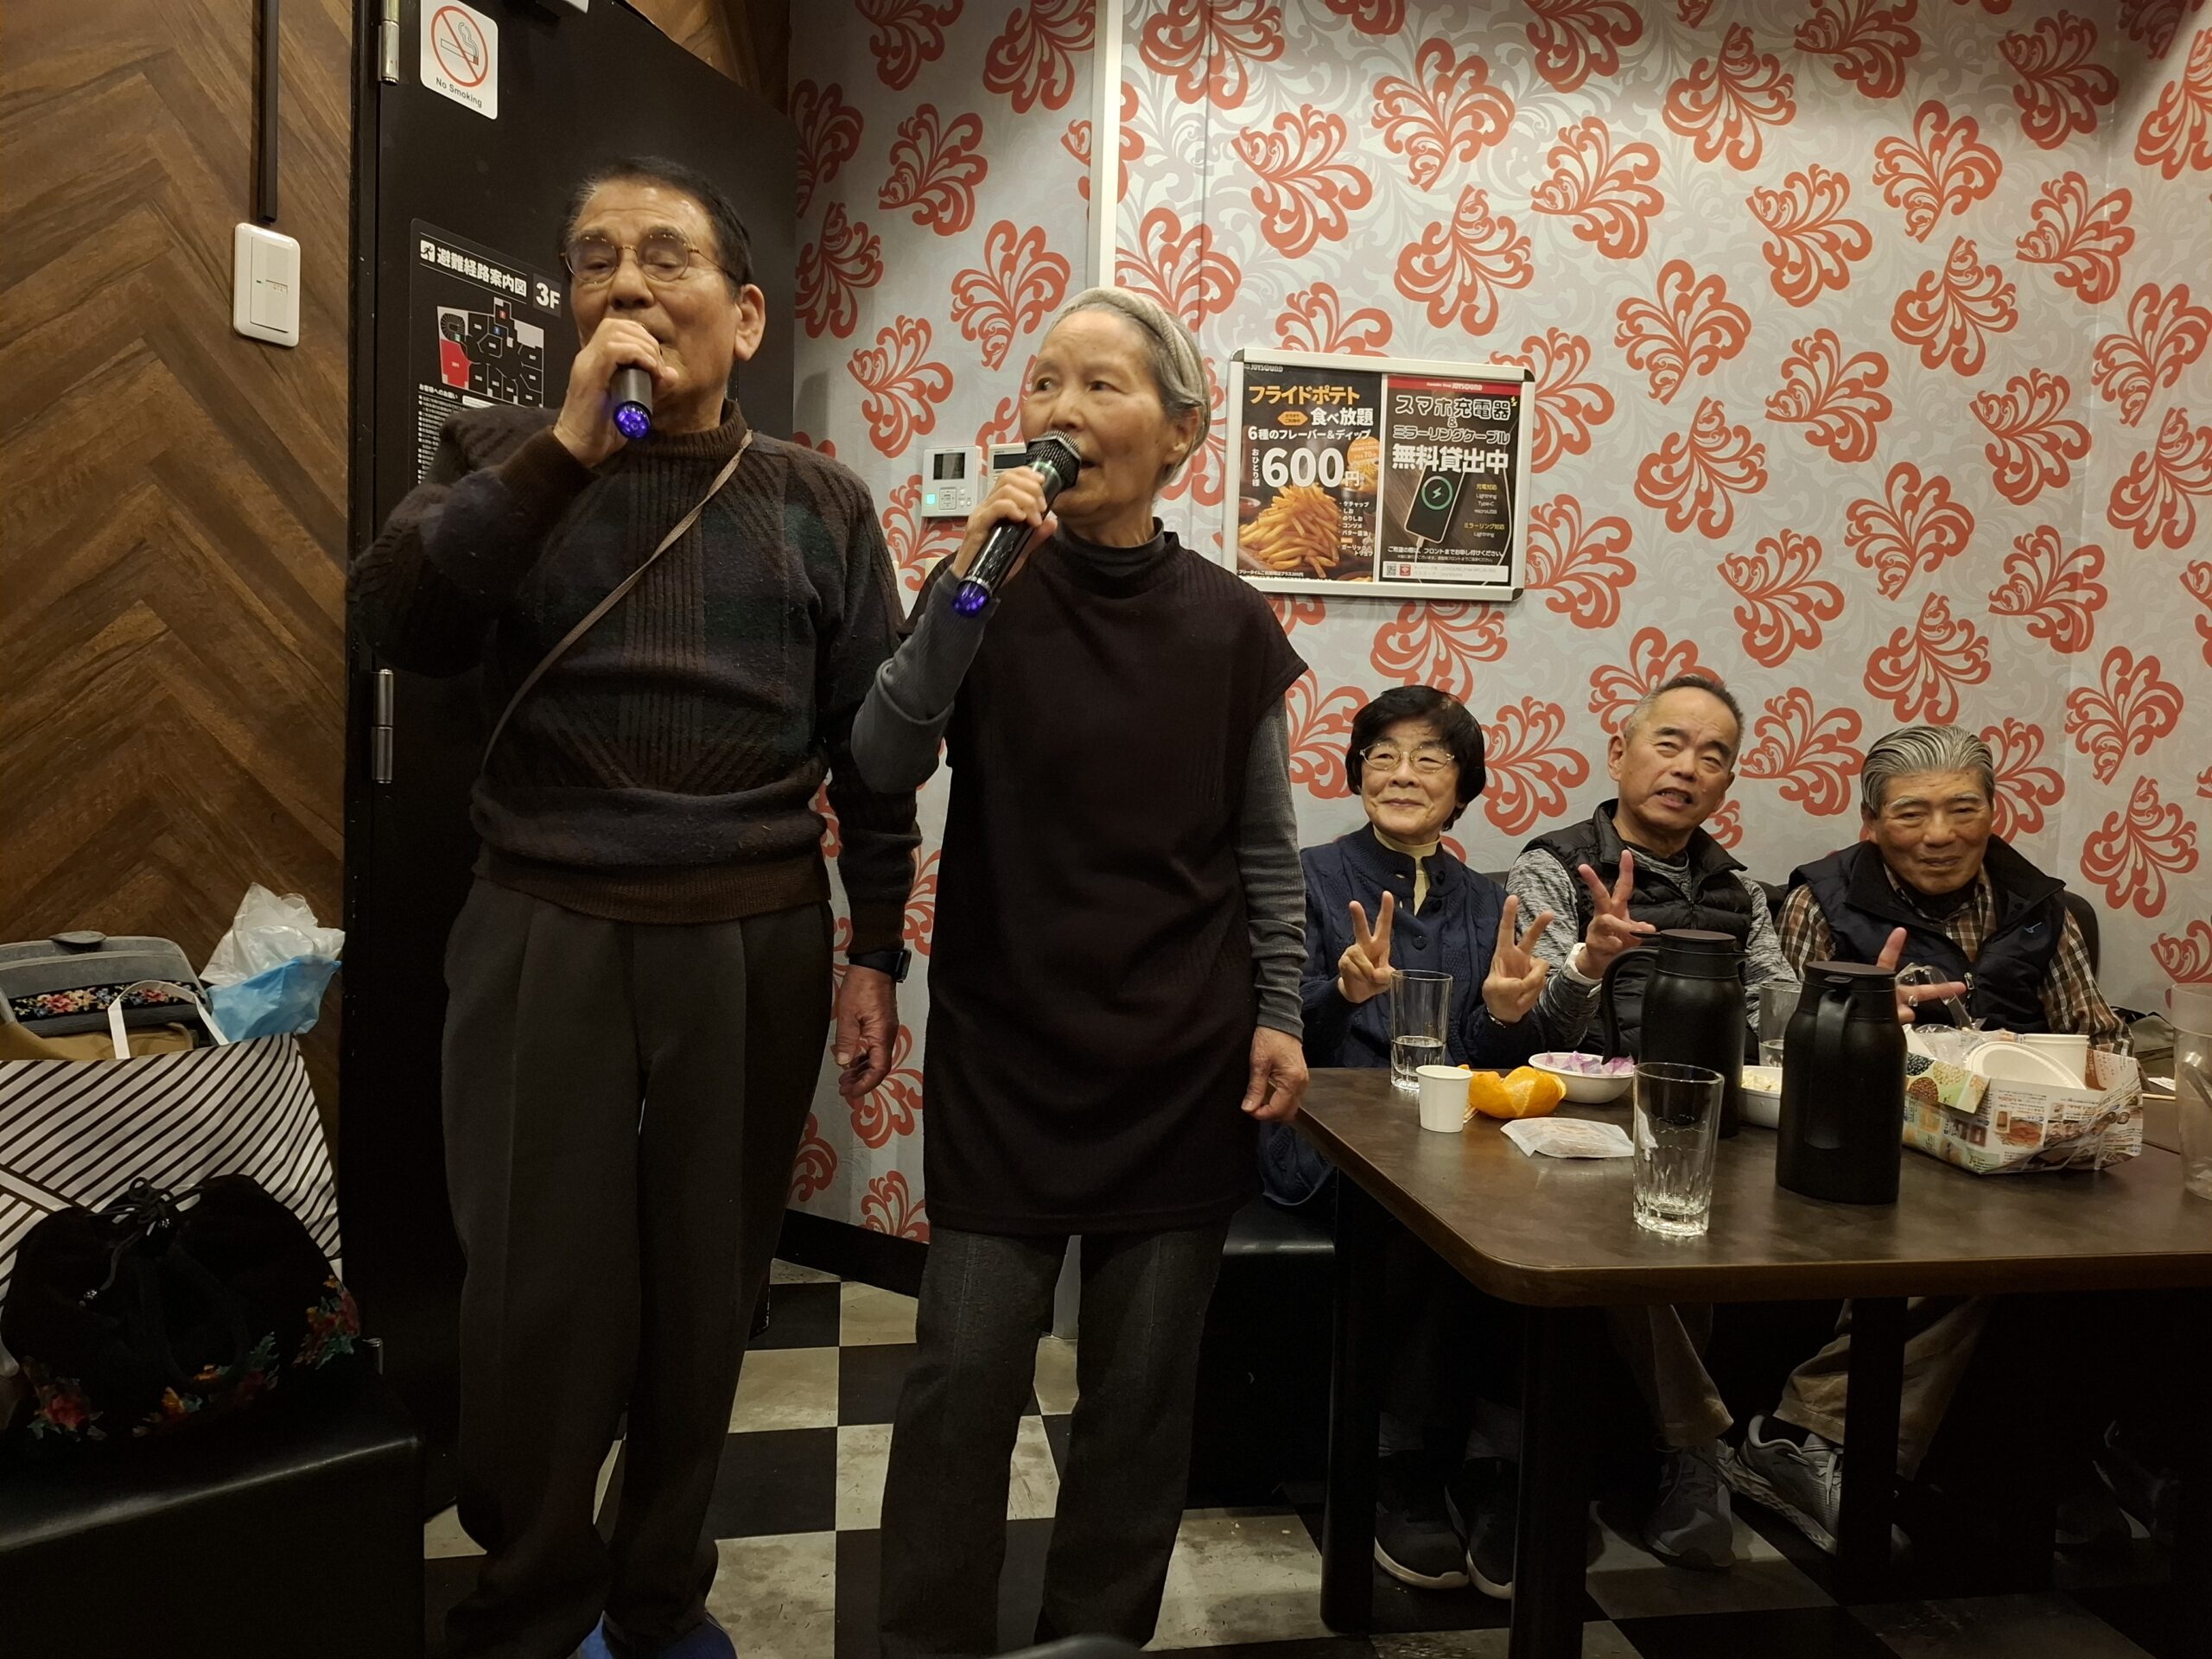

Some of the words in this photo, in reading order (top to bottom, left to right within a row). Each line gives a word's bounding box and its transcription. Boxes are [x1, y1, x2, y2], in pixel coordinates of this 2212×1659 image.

[435, 76, 448, 89] No
[449, 84, 483, 109] Smoking
[436, 247, 527, 298] 避難経路案内図
[535, 282, 561, 309] 3F
[1249, 385, 1360, 404] フライドポテト
[1452, 383, 1483, 391] JOYSOUND
[1311, 407, 1374, 426] 食べ放題
[1395, 395, 1511, 421] スマホ充電器
[1447, 417, 1458, 428] &
[1248, 425, 1371, 441] 6種のフレーバー&ディップ
[1393, 425, 1511, 445] ミラーリングケーブル
[1392, 443, 1510, 474] 無料貸出中
